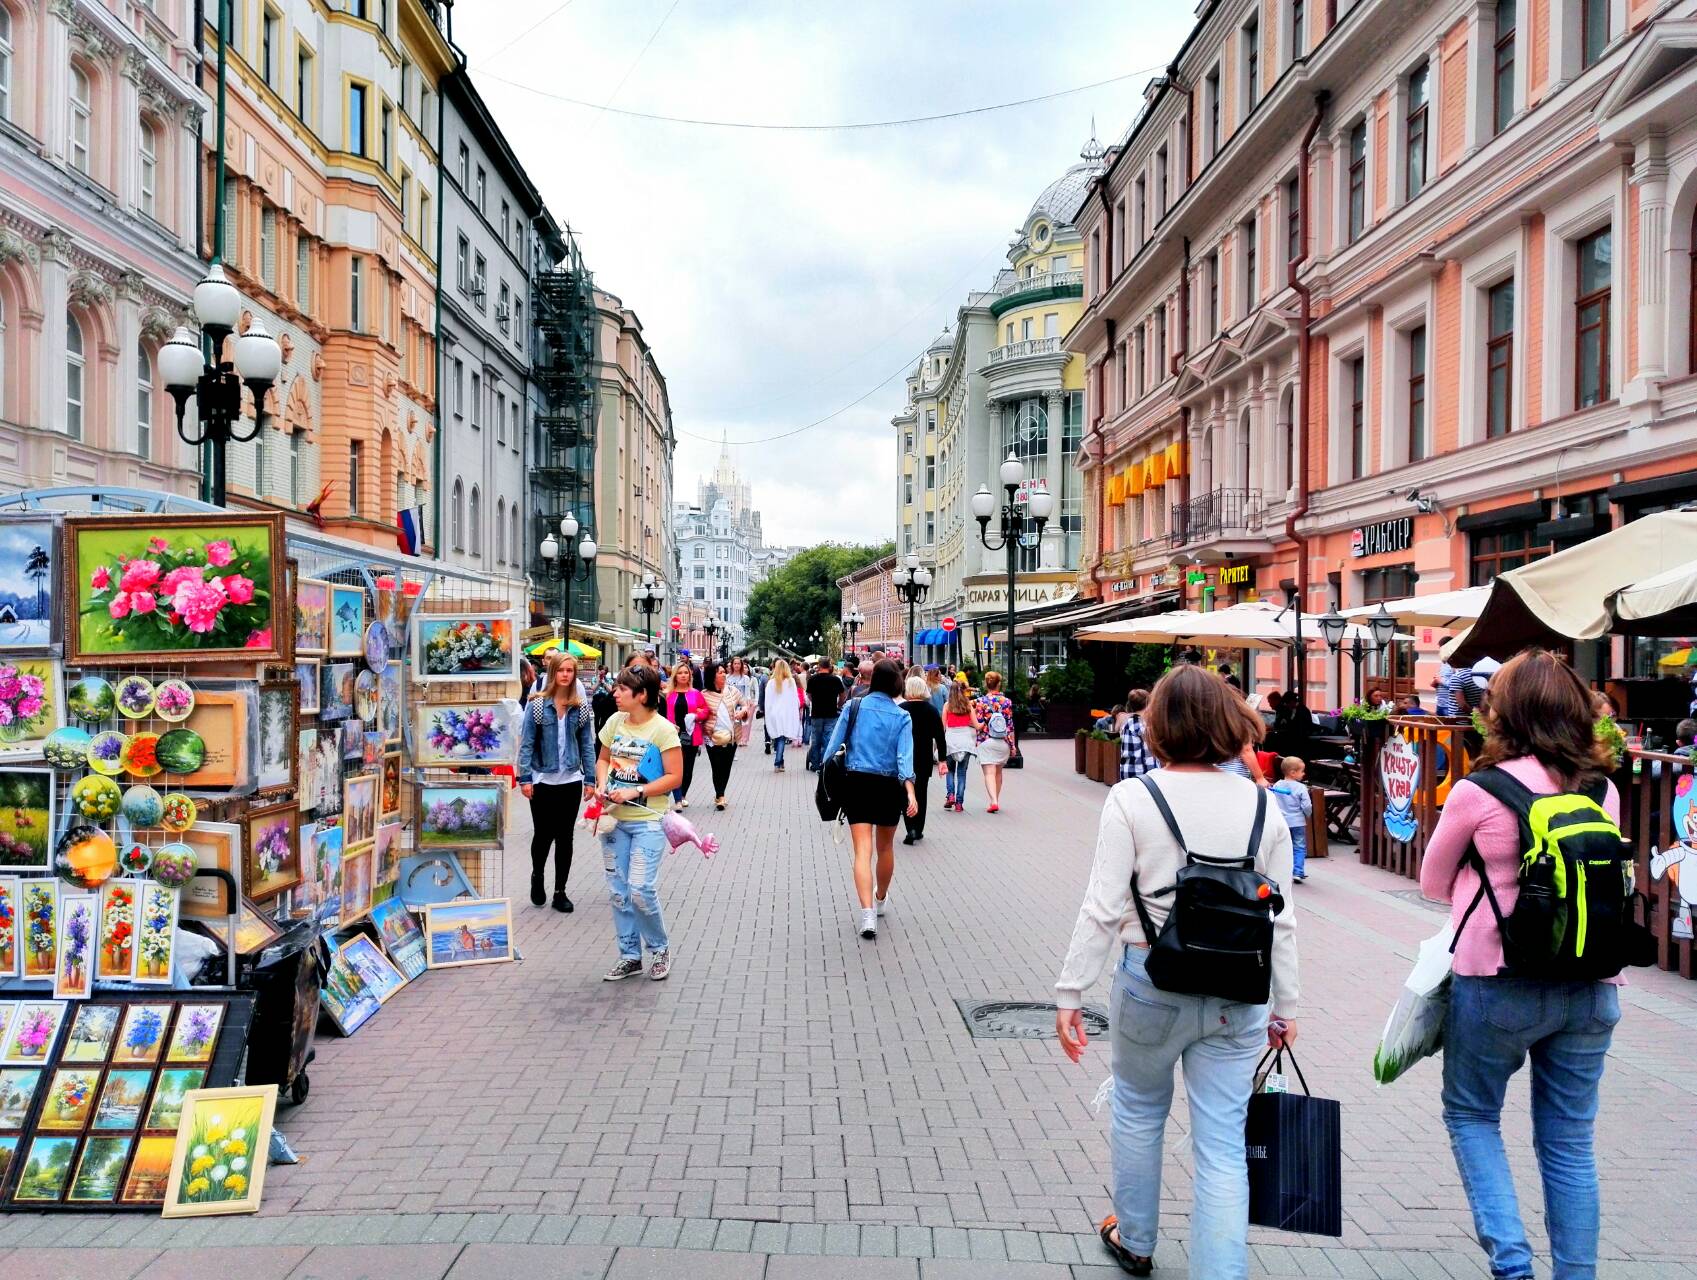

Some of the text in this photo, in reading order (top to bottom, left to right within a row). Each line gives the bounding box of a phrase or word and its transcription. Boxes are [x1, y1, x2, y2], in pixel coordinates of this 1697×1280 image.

[1364, 517, 1410, 556] КРАБСТЕР
[1219, 565, 1249, 585] РАРИТЕТ
[969, 589, 1000, 604] СТАРАЯ
[1383, 750, 1418, 781] KRUSTY
